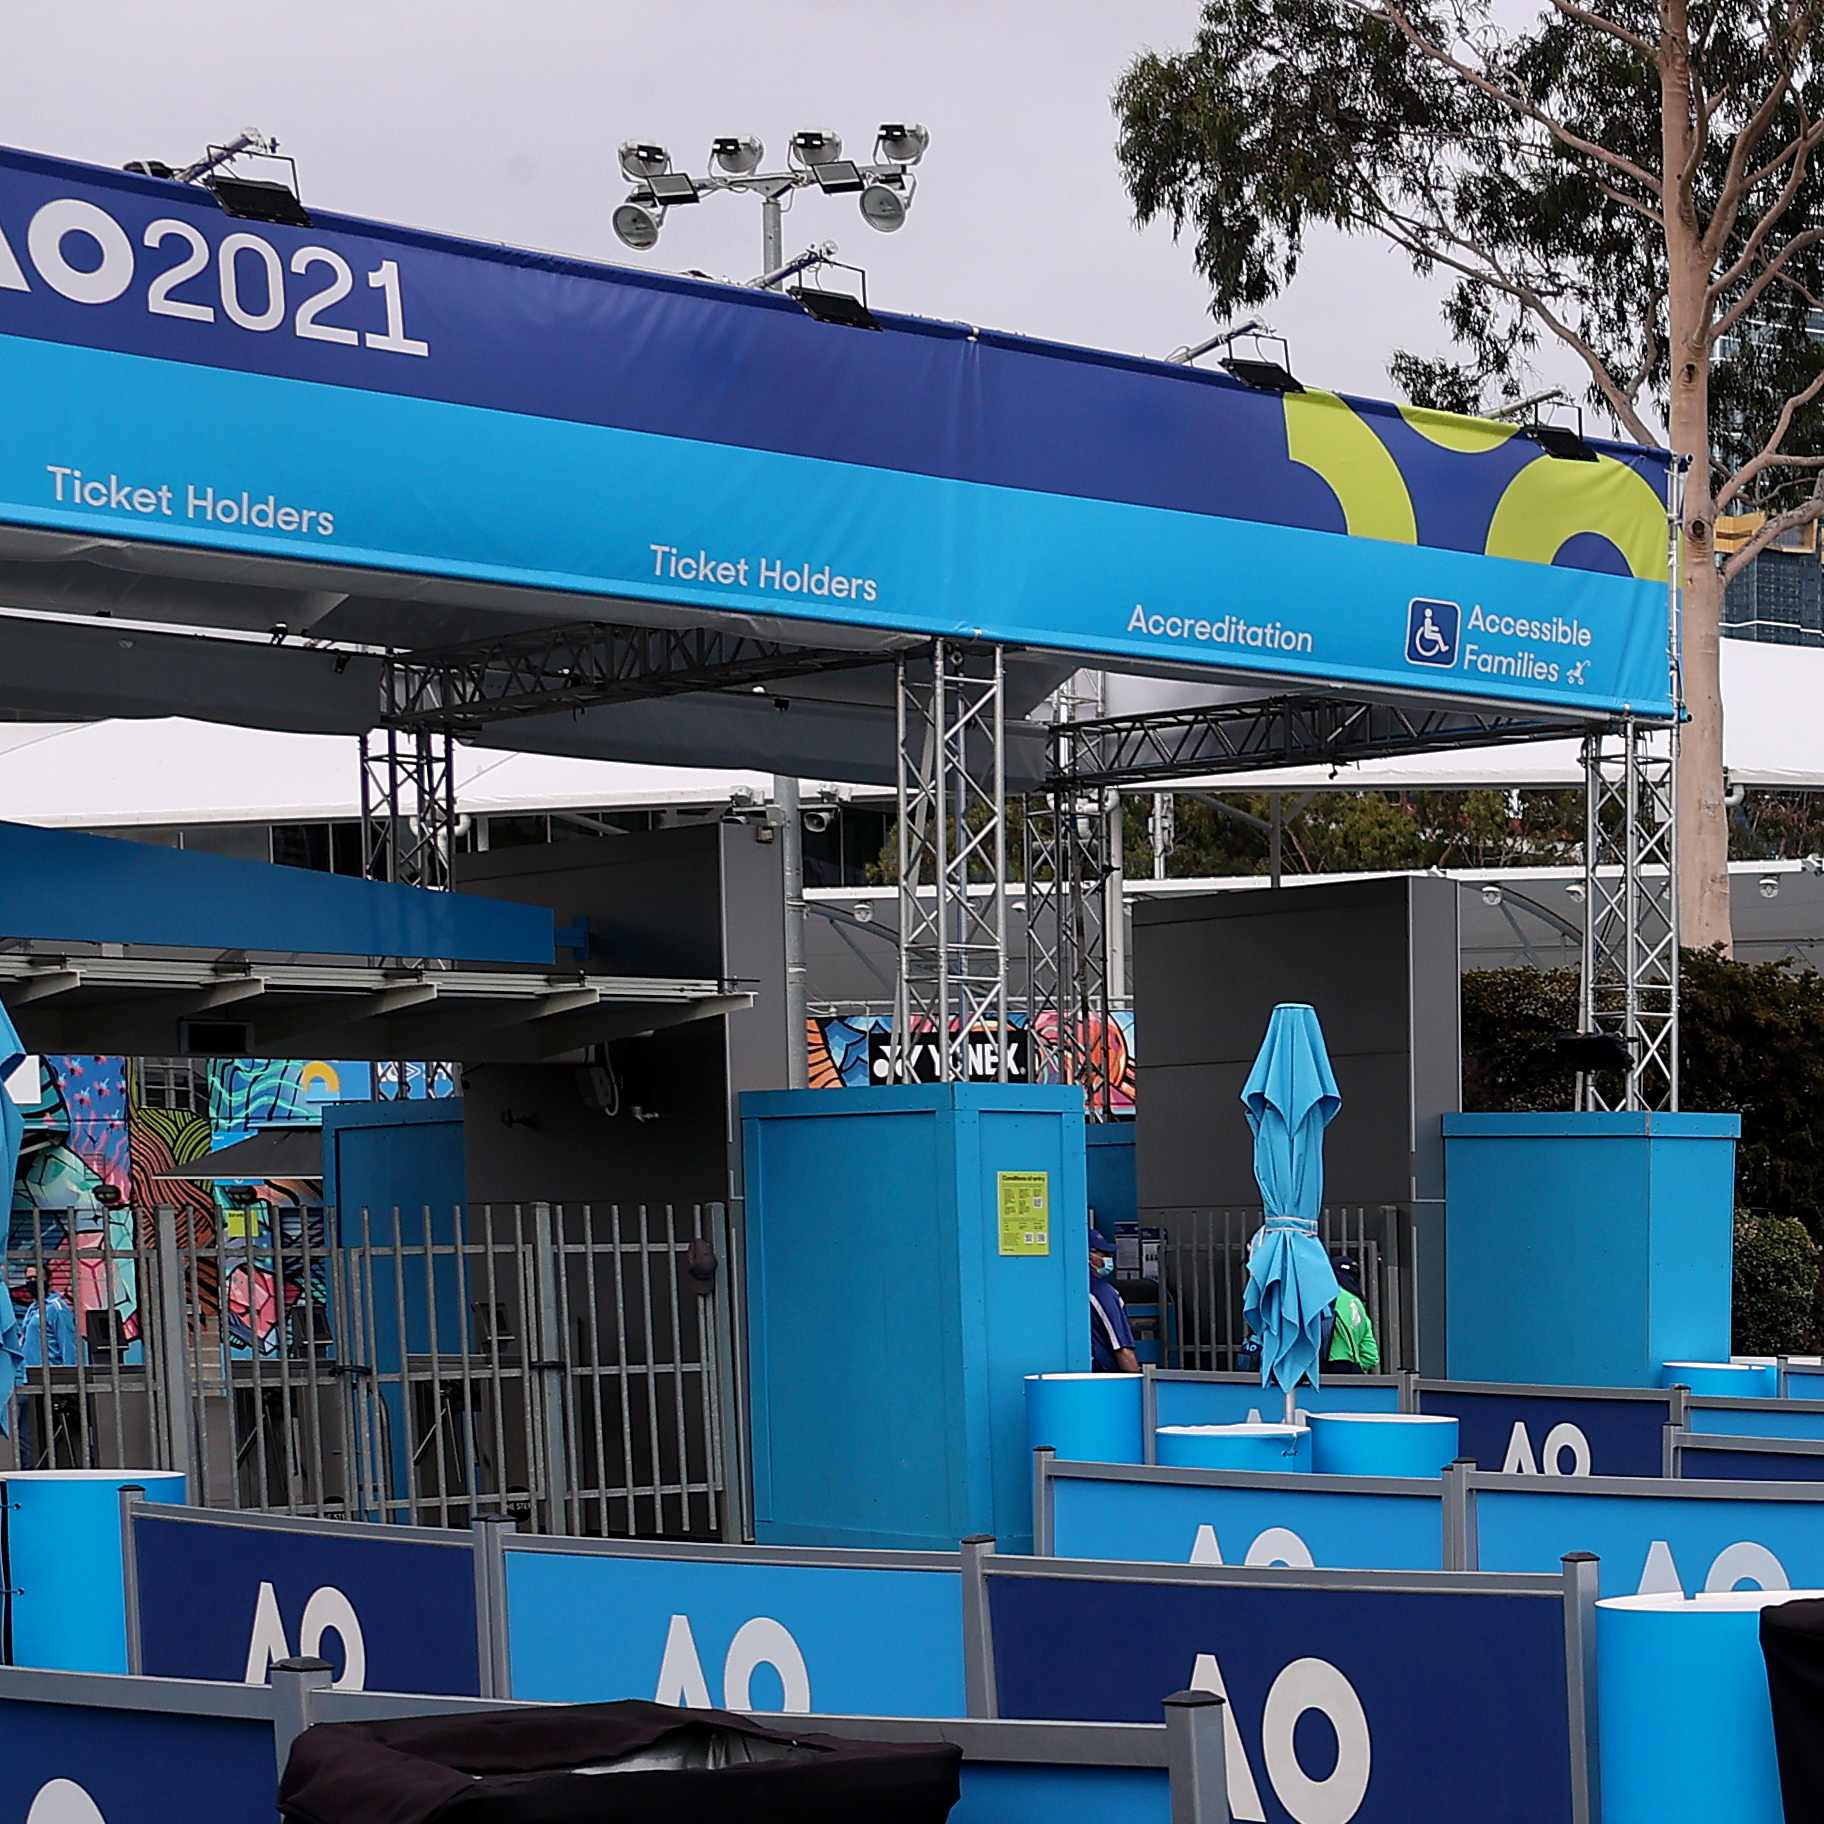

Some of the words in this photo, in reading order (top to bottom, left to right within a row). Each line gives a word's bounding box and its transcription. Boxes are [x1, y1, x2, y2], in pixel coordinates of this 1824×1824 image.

[46, 464, 173, 517] Ticket
[186, 486, 334, 537] Holders
[650, 544, 748, 588] Ticket
[759, 558, 879, 602] Holders
[1127, 603, 1314, 654] Accreditation
[1467, 604, 1593, 648] Accessible
[1464, 643, 1560, 683] Families
